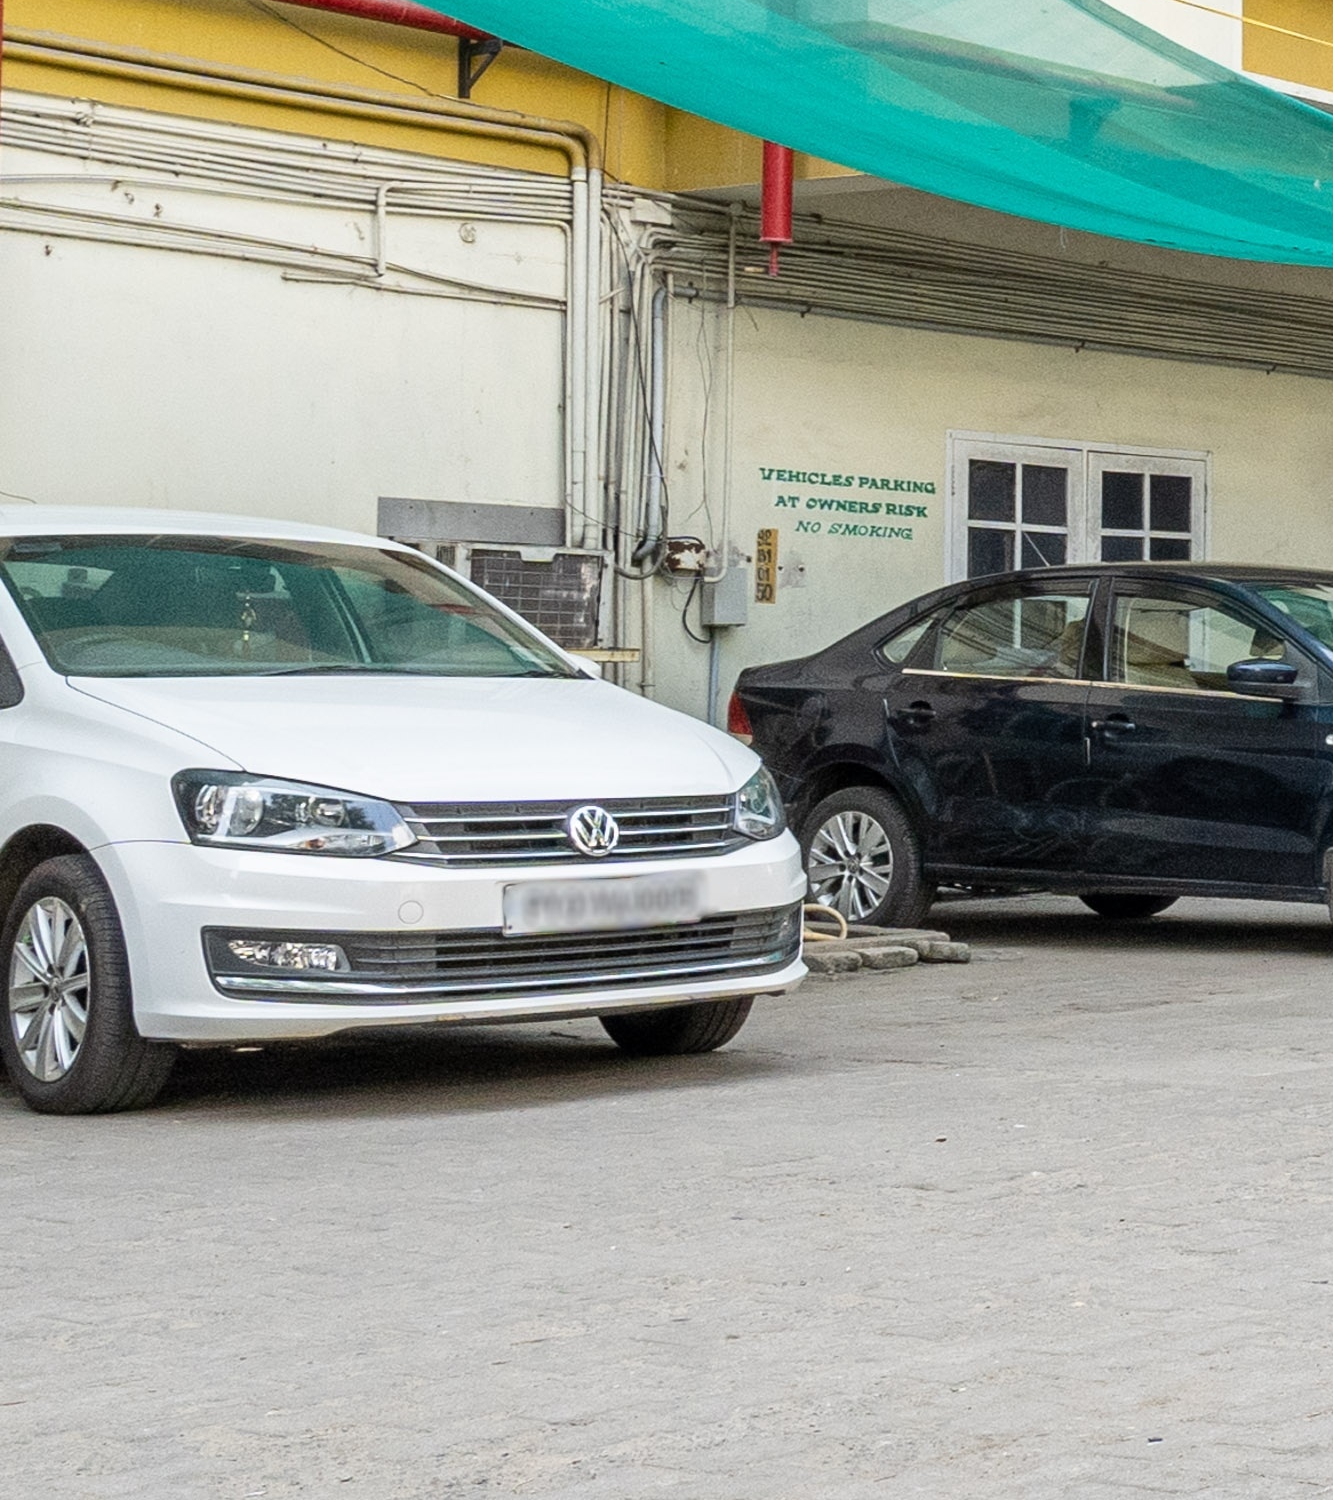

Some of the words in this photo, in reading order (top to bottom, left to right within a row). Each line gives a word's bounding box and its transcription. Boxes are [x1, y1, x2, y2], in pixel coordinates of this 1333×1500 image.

[759, 467, 855, 487] VEHICLES
[858, 476, 936, 494] PARKING
[774, 495, 800, 508] AT
[885, 502, 928, 518] RISK
[795, 520, 822, 534] NO
[828, 522, 913, 541] SMOKING
